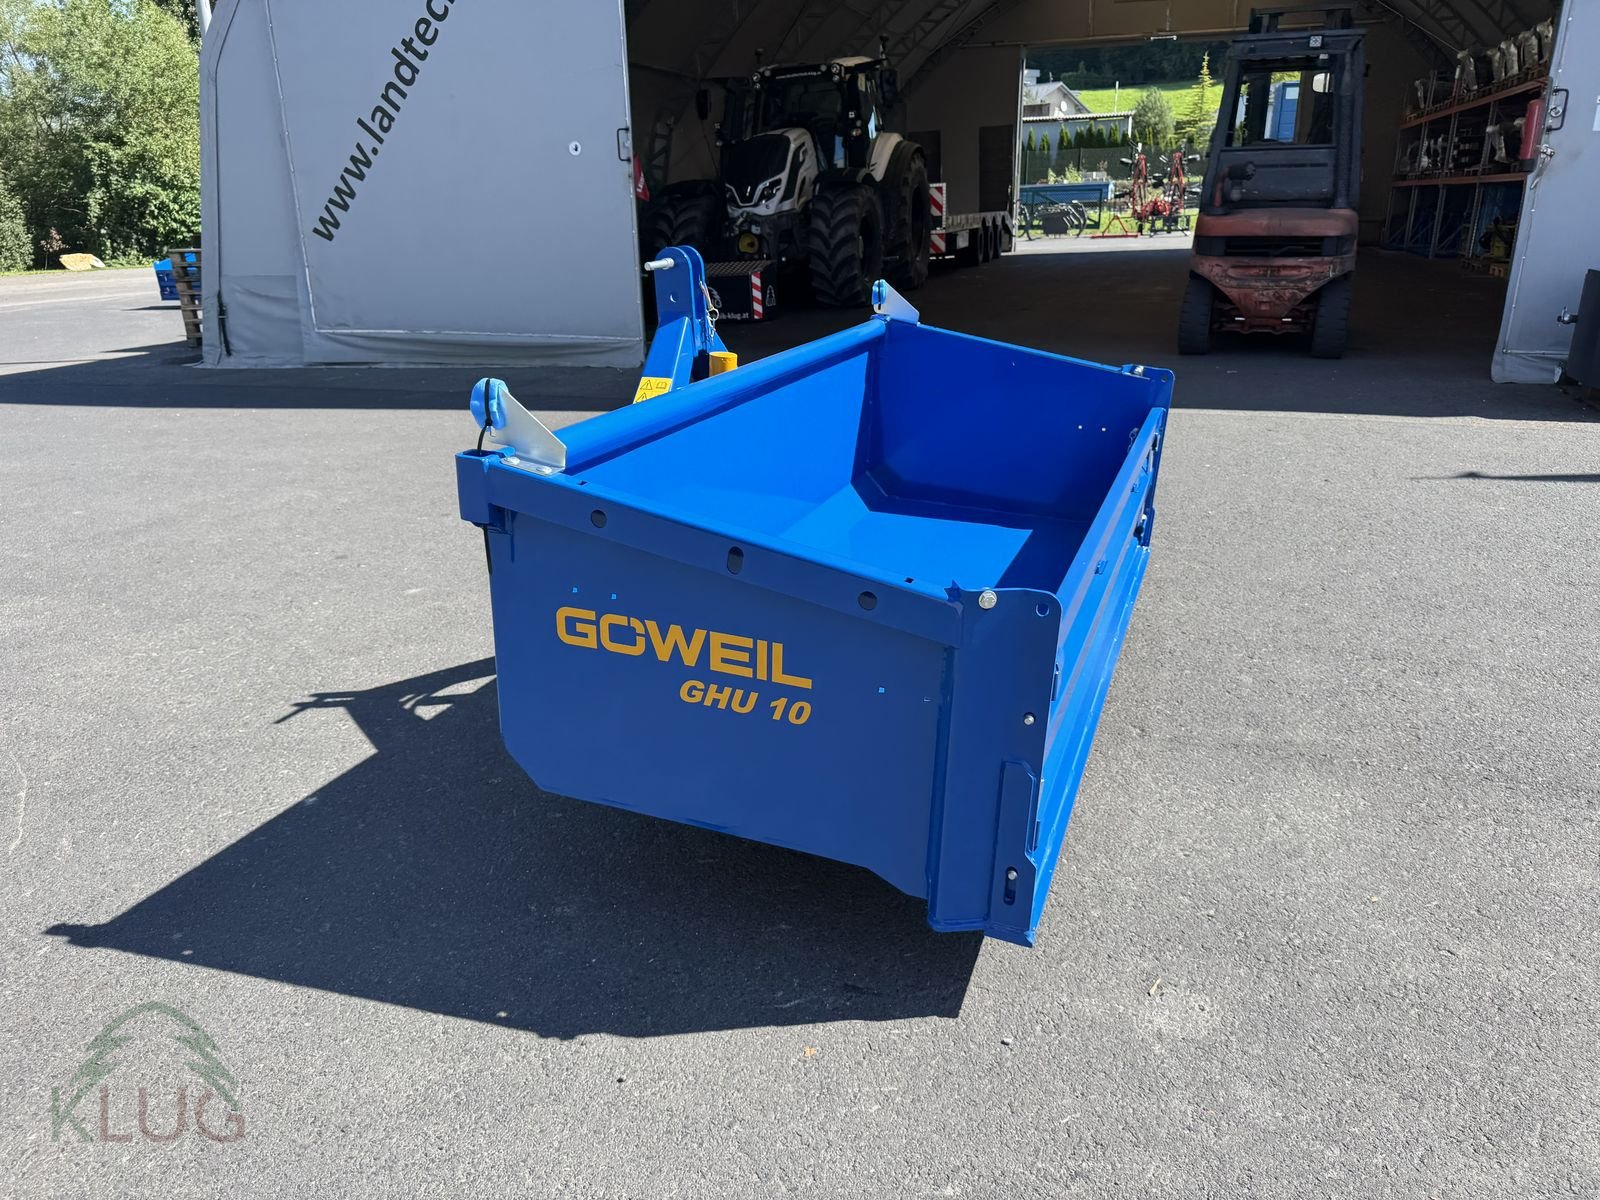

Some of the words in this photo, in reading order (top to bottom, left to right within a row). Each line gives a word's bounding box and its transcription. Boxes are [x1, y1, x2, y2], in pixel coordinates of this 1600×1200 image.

[312, 0, 456, 242] www.landtec
[679, 679, 759, 714] GHU
[769, 697, 812, 725] 10
